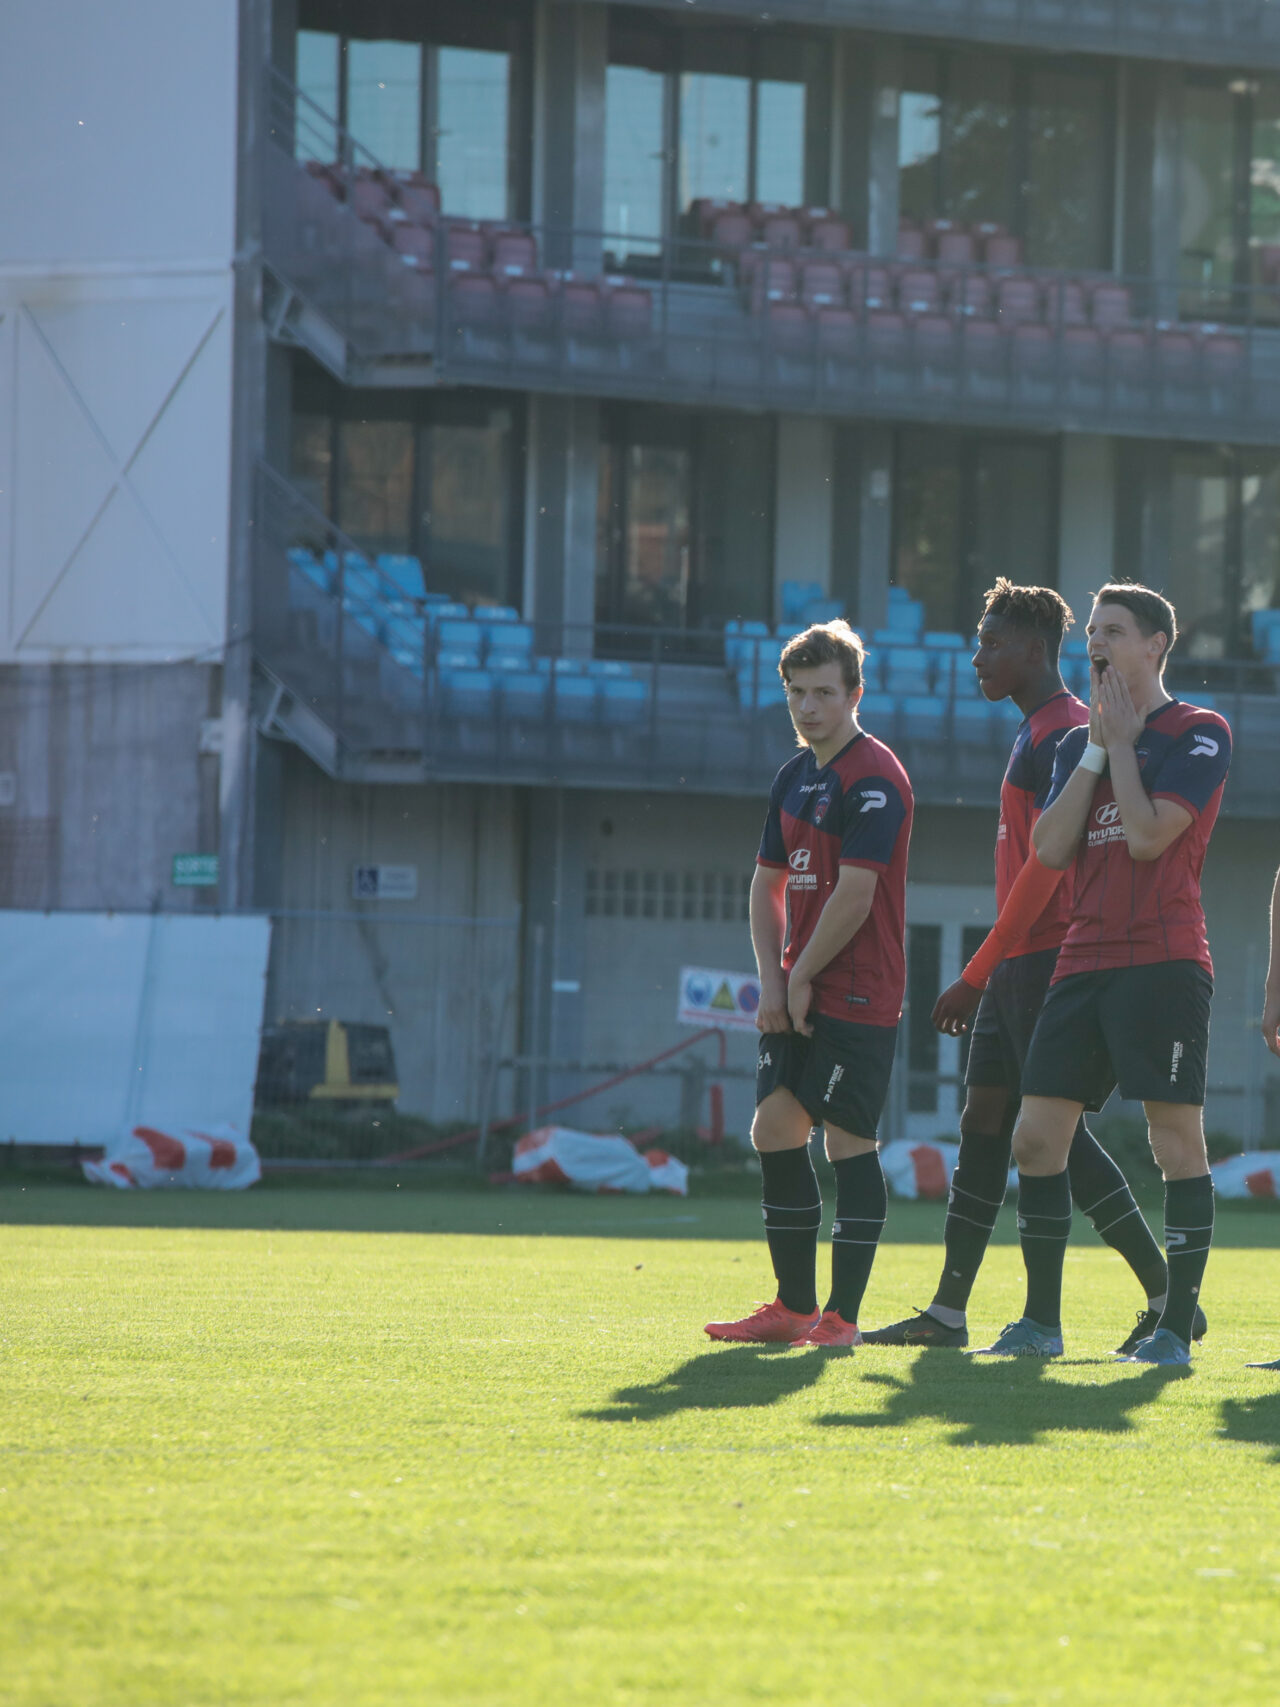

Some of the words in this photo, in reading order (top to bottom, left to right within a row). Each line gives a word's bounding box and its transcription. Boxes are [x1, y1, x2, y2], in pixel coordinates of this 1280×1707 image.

[1088, 825, 1125, 840] HYUNDA
[1172, 1041, 1180, 1072] PATRICK
[828, 1063, 842, 1094] PATRICK
